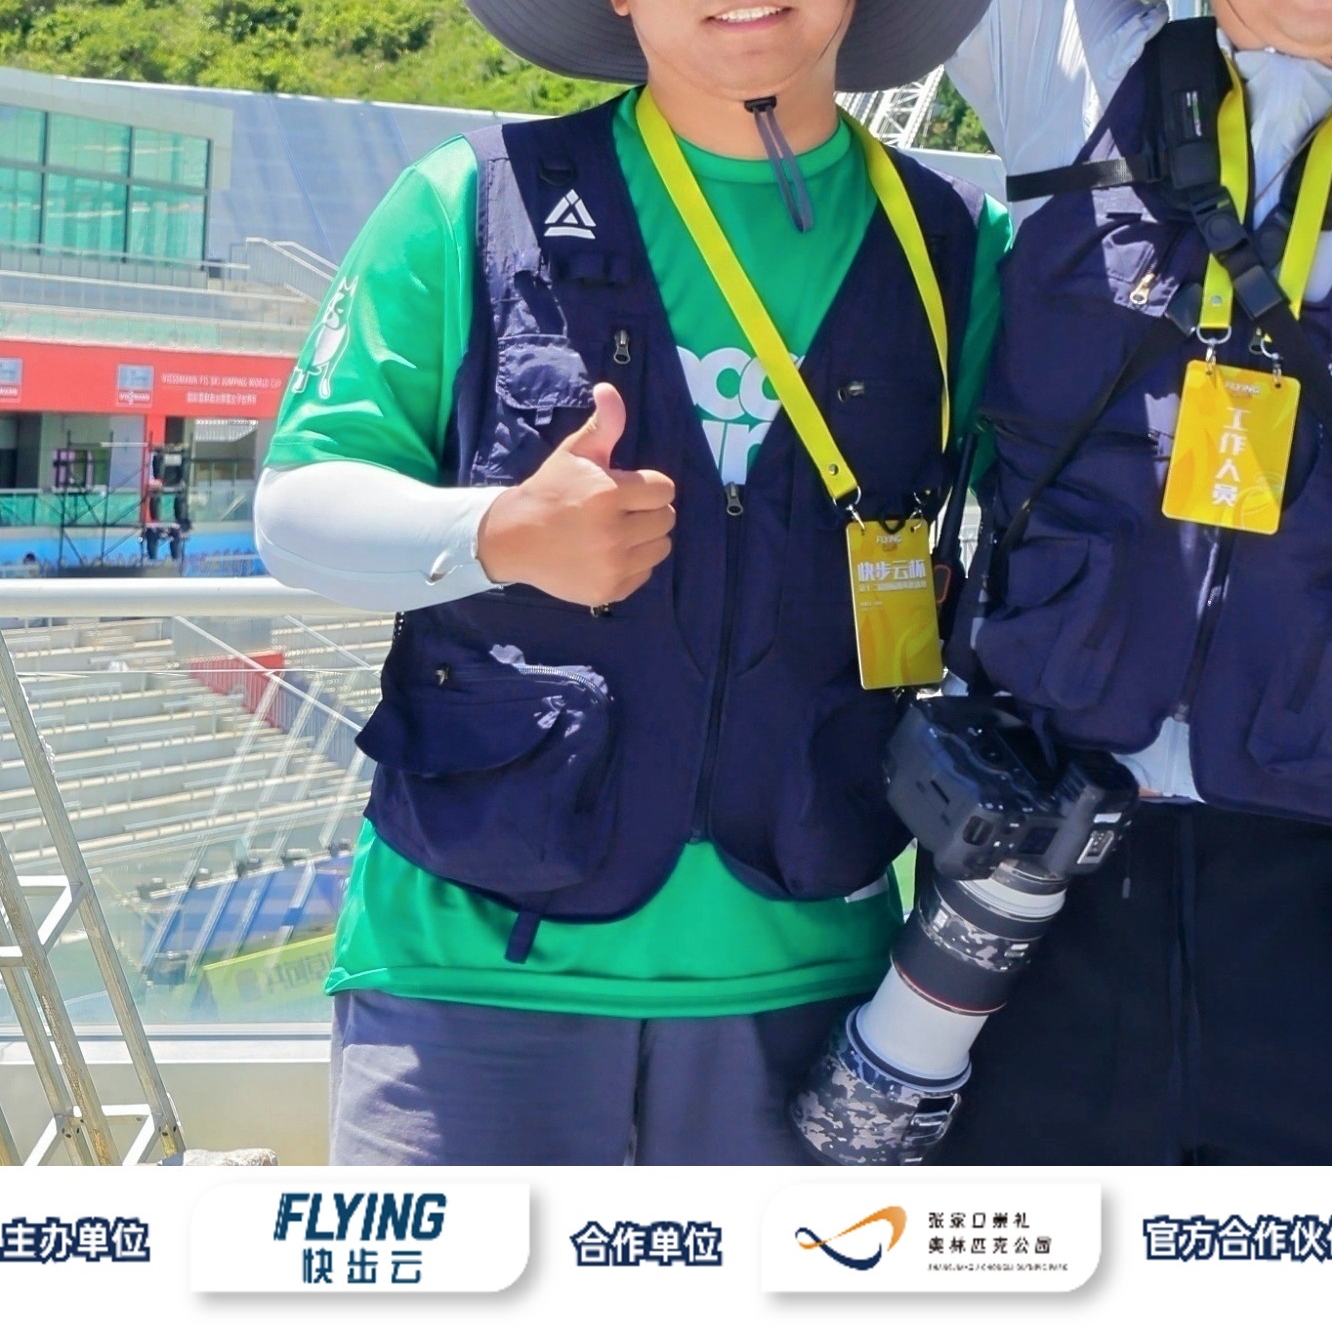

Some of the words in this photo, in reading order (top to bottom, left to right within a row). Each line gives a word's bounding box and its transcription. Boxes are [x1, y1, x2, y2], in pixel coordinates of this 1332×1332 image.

[1212, 406, 1251, 507] 工作人员
[857, 559, 927, 582] 快步云杯
